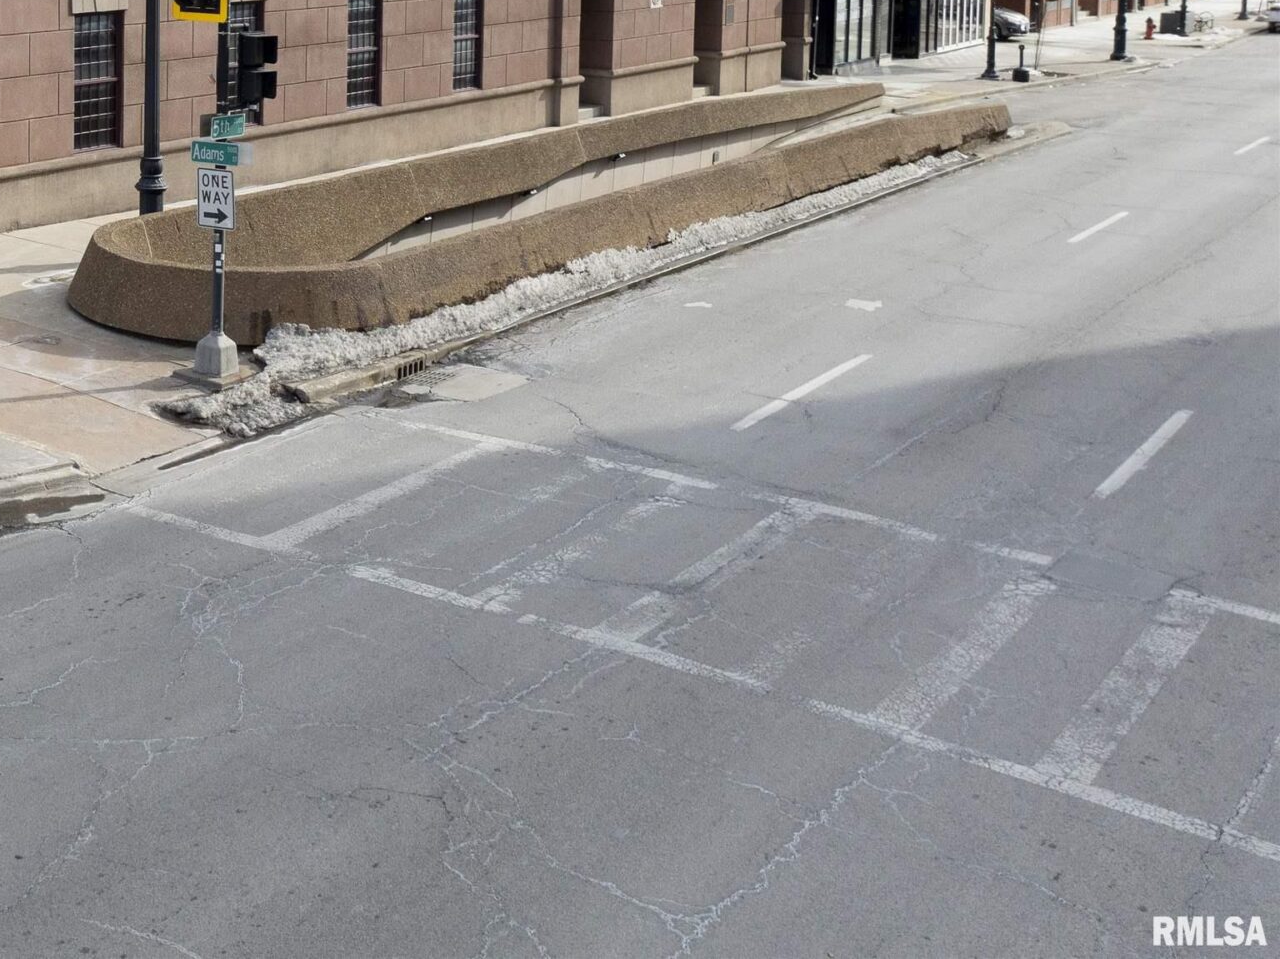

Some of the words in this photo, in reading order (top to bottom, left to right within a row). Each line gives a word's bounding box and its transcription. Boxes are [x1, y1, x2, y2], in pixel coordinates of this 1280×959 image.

[213, 120, 230, 137] 5th
[192, 143, 225, 161] Adams
[202, 173, 228, 189] ONE
[202, 190, 230, 205] WAY
